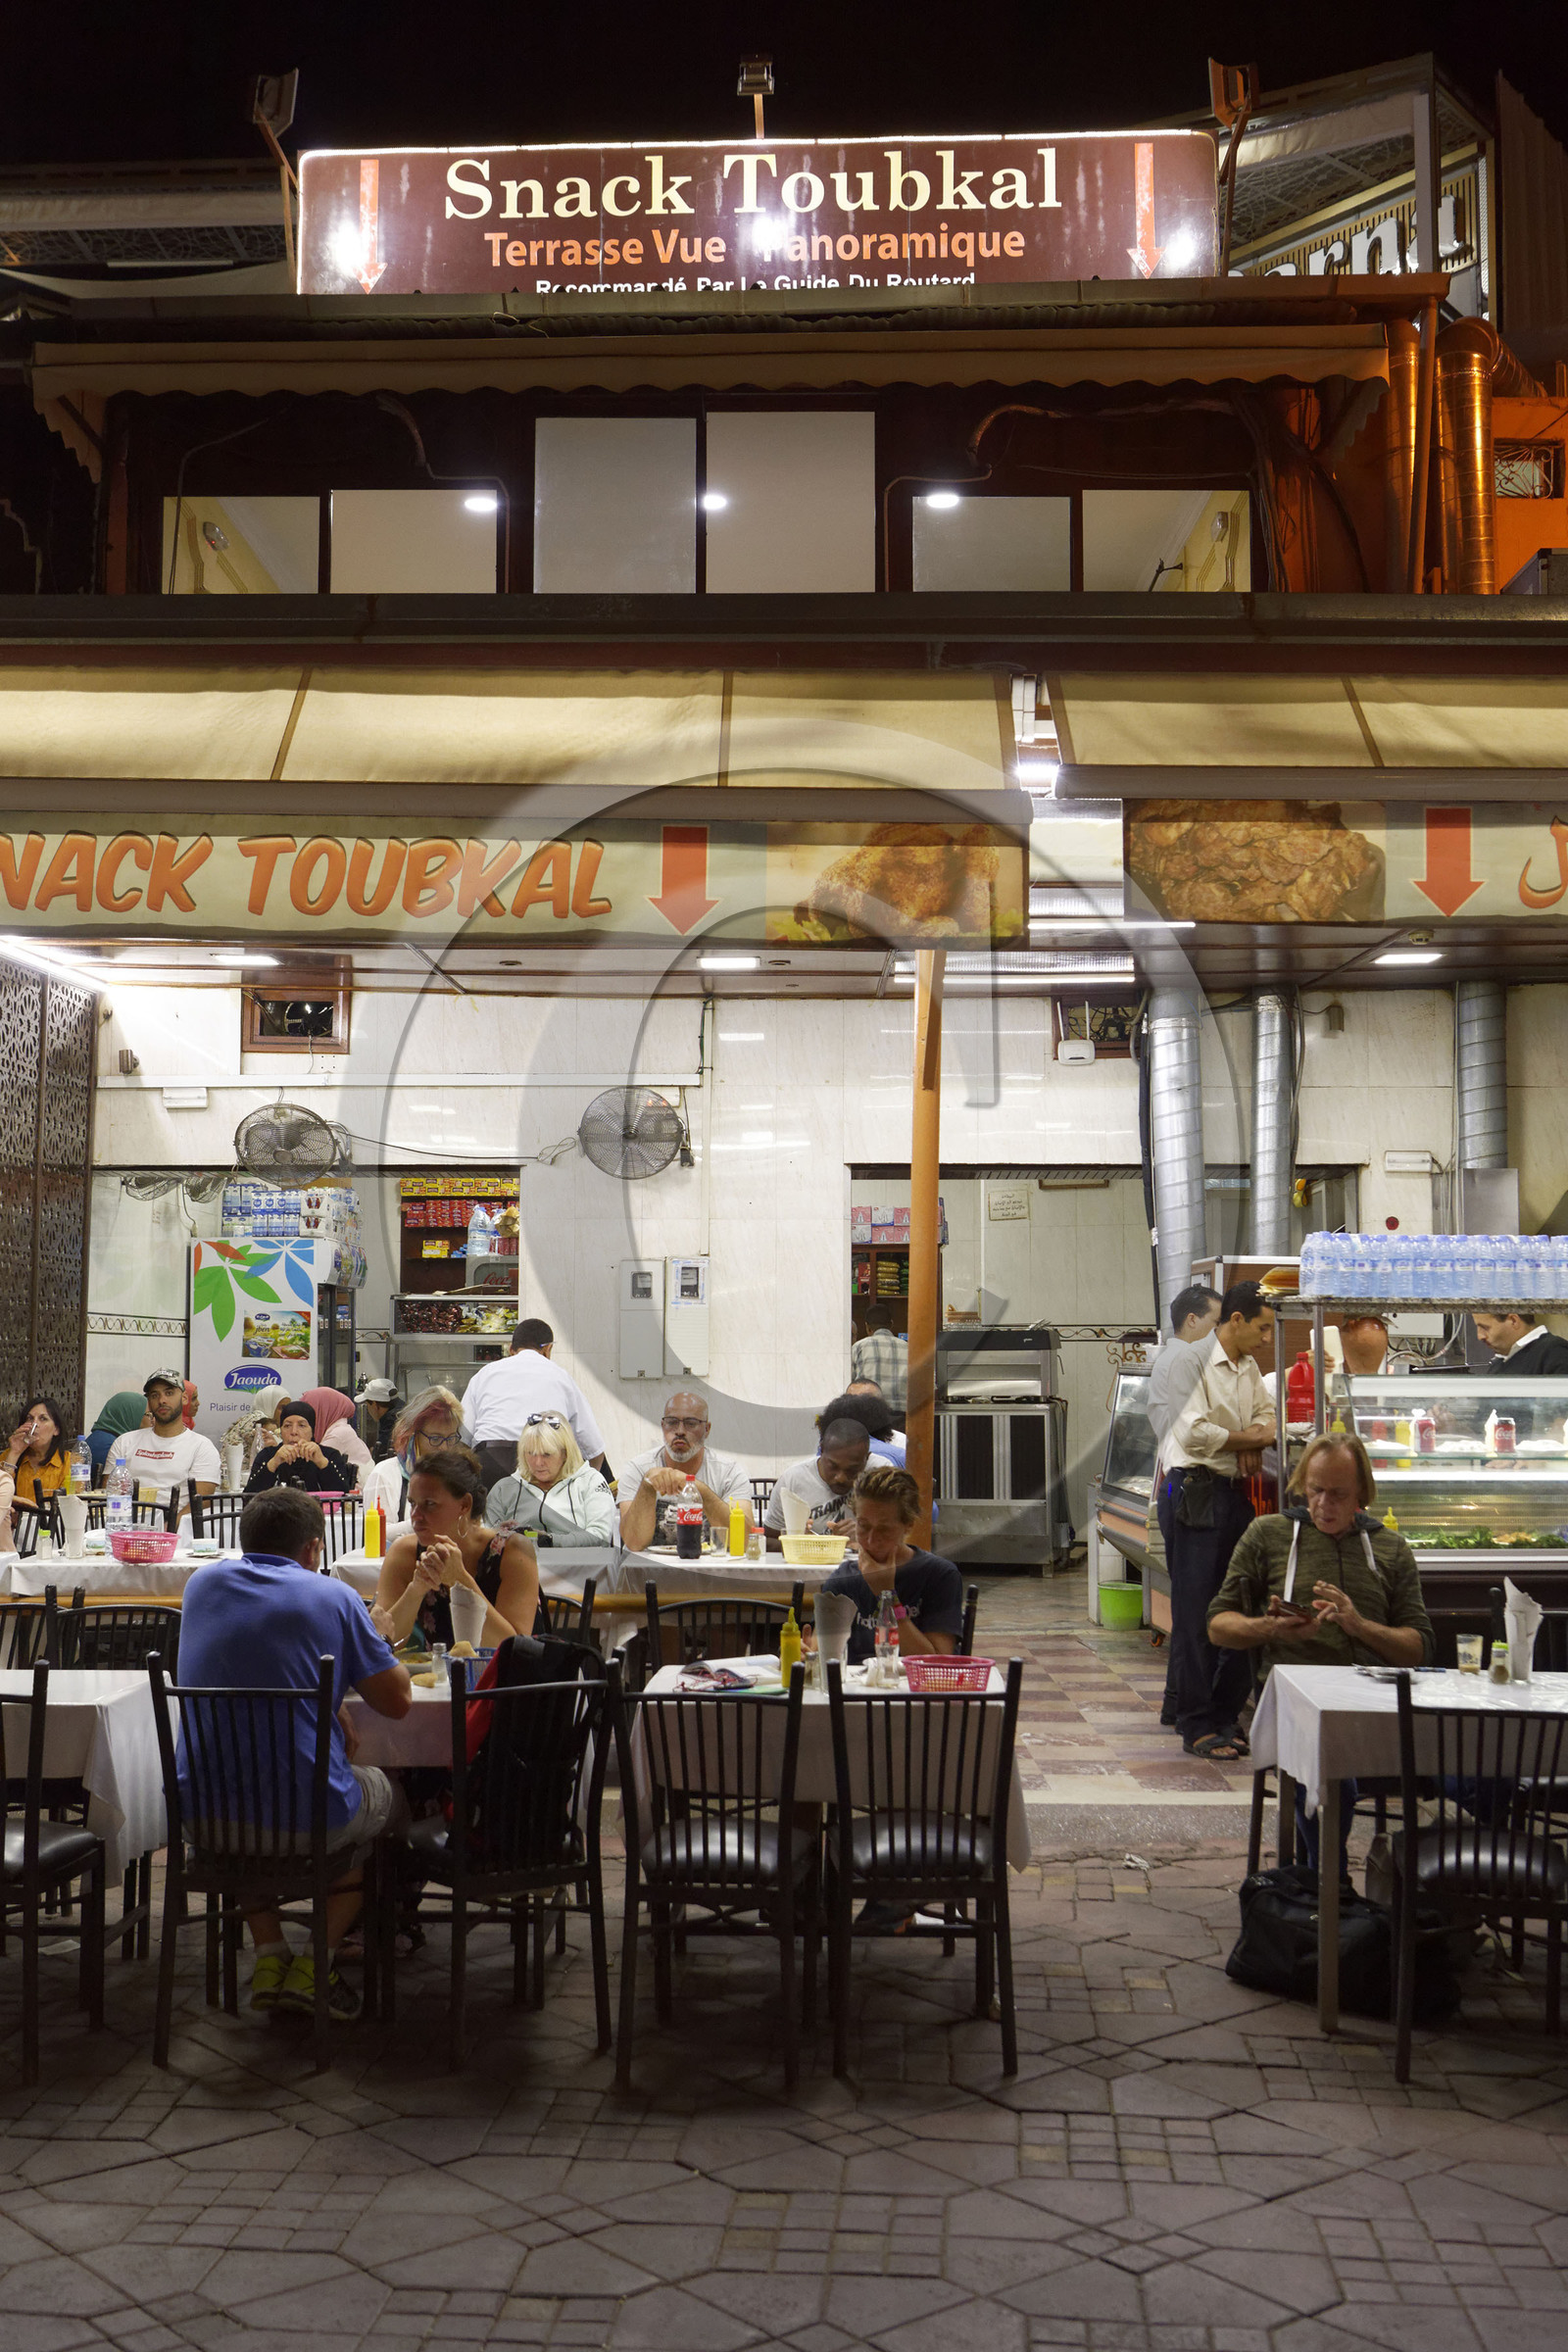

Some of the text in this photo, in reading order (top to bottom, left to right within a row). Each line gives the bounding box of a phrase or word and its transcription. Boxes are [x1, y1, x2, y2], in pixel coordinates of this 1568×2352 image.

[444, 148, 1062, 220] Snack Toubkal
[484, 230, 644, 267] Terrasse
[651, 228, 727, 264] Vue
[774, 274, 840, 291] Guide
[237, 834, 612, 919] TOUBKAL
[229, 1372, 278, 1388] Jaouda
[210, 1402, 251, 1412] Plaisir de
